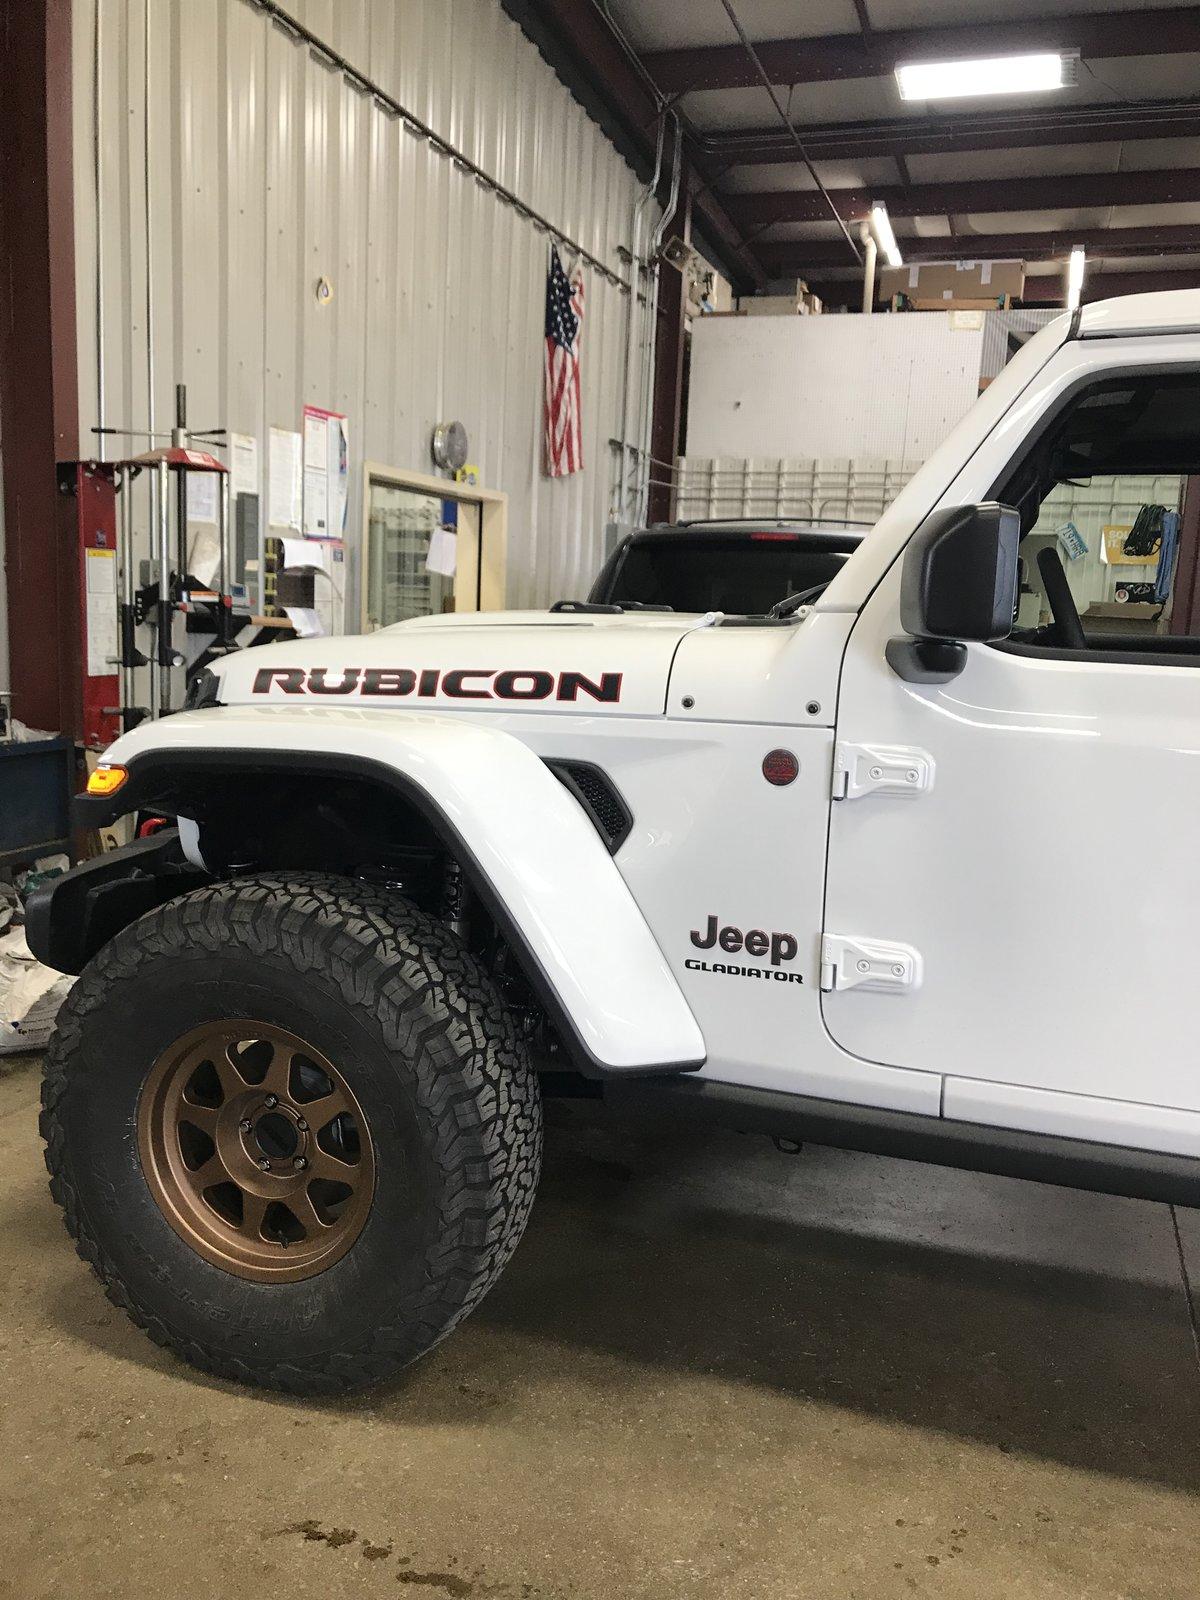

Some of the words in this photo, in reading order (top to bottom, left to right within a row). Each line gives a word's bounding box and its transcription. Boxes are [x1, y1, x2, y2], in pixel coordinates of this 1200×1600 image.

[252, 668, 623, 702] RUBICON
[690, 914, 798, 966] Jeep
[684, 959, 804, 984] GLADIATOR
